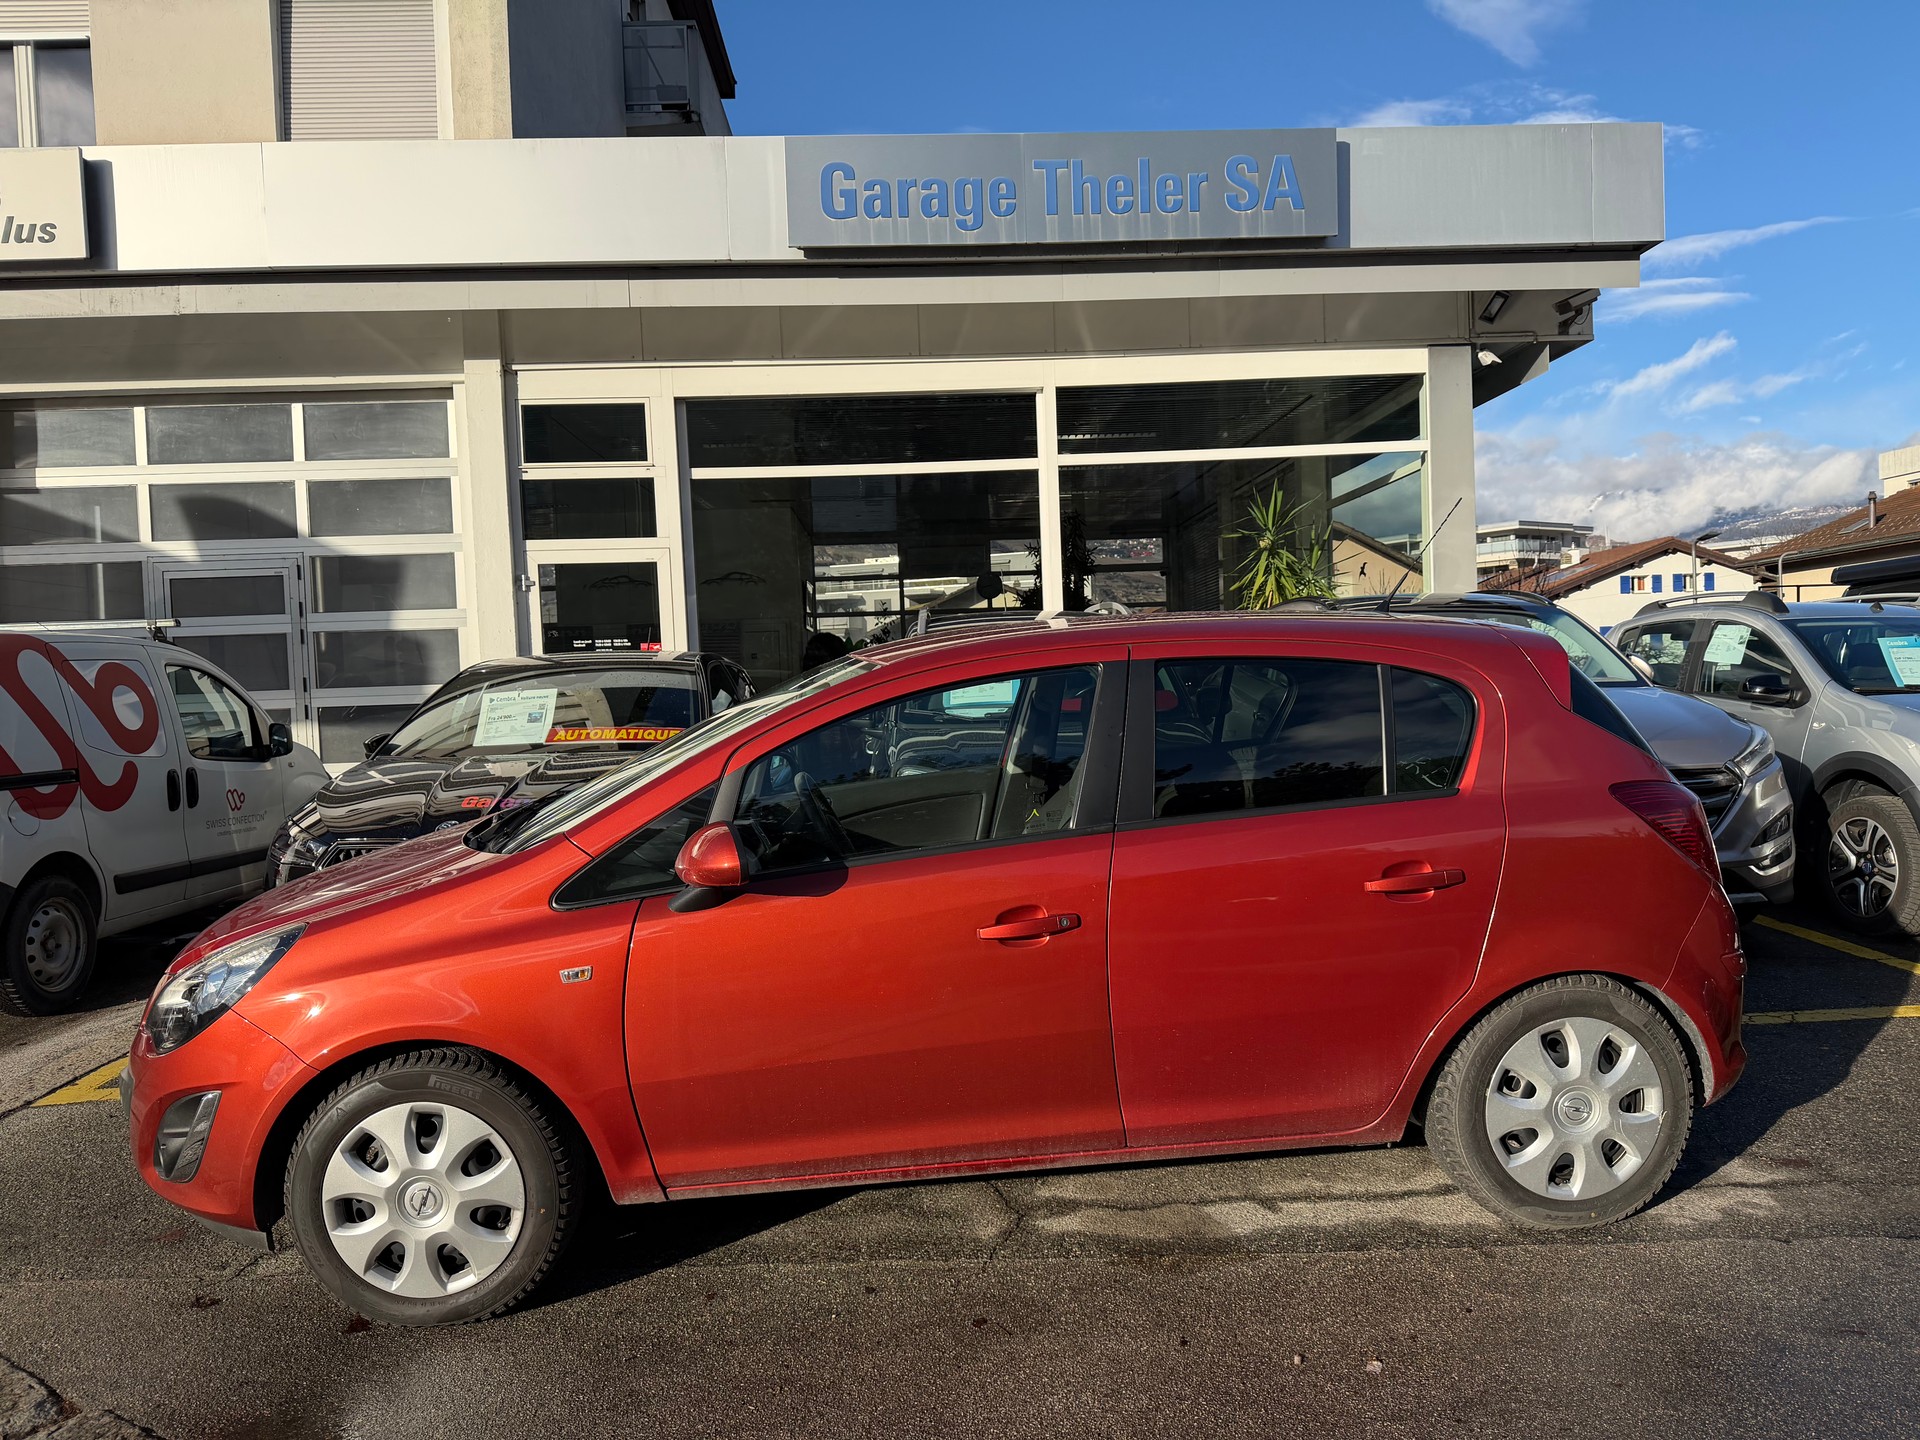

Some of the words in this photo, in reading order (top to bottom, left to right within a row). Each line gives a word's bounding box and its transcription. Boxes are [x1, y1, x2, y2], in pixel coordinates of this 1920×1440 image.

[820, 160, 1018, 232] Garage
[1032, 156, 1208, 217] Theler
[1224, 153, 1306, 213] SA
[205, 818, 227, 830] SWISS
[227, 813, 265, 826] CONFECTION
[427, 1073, 482, 1099] PIRELLI
